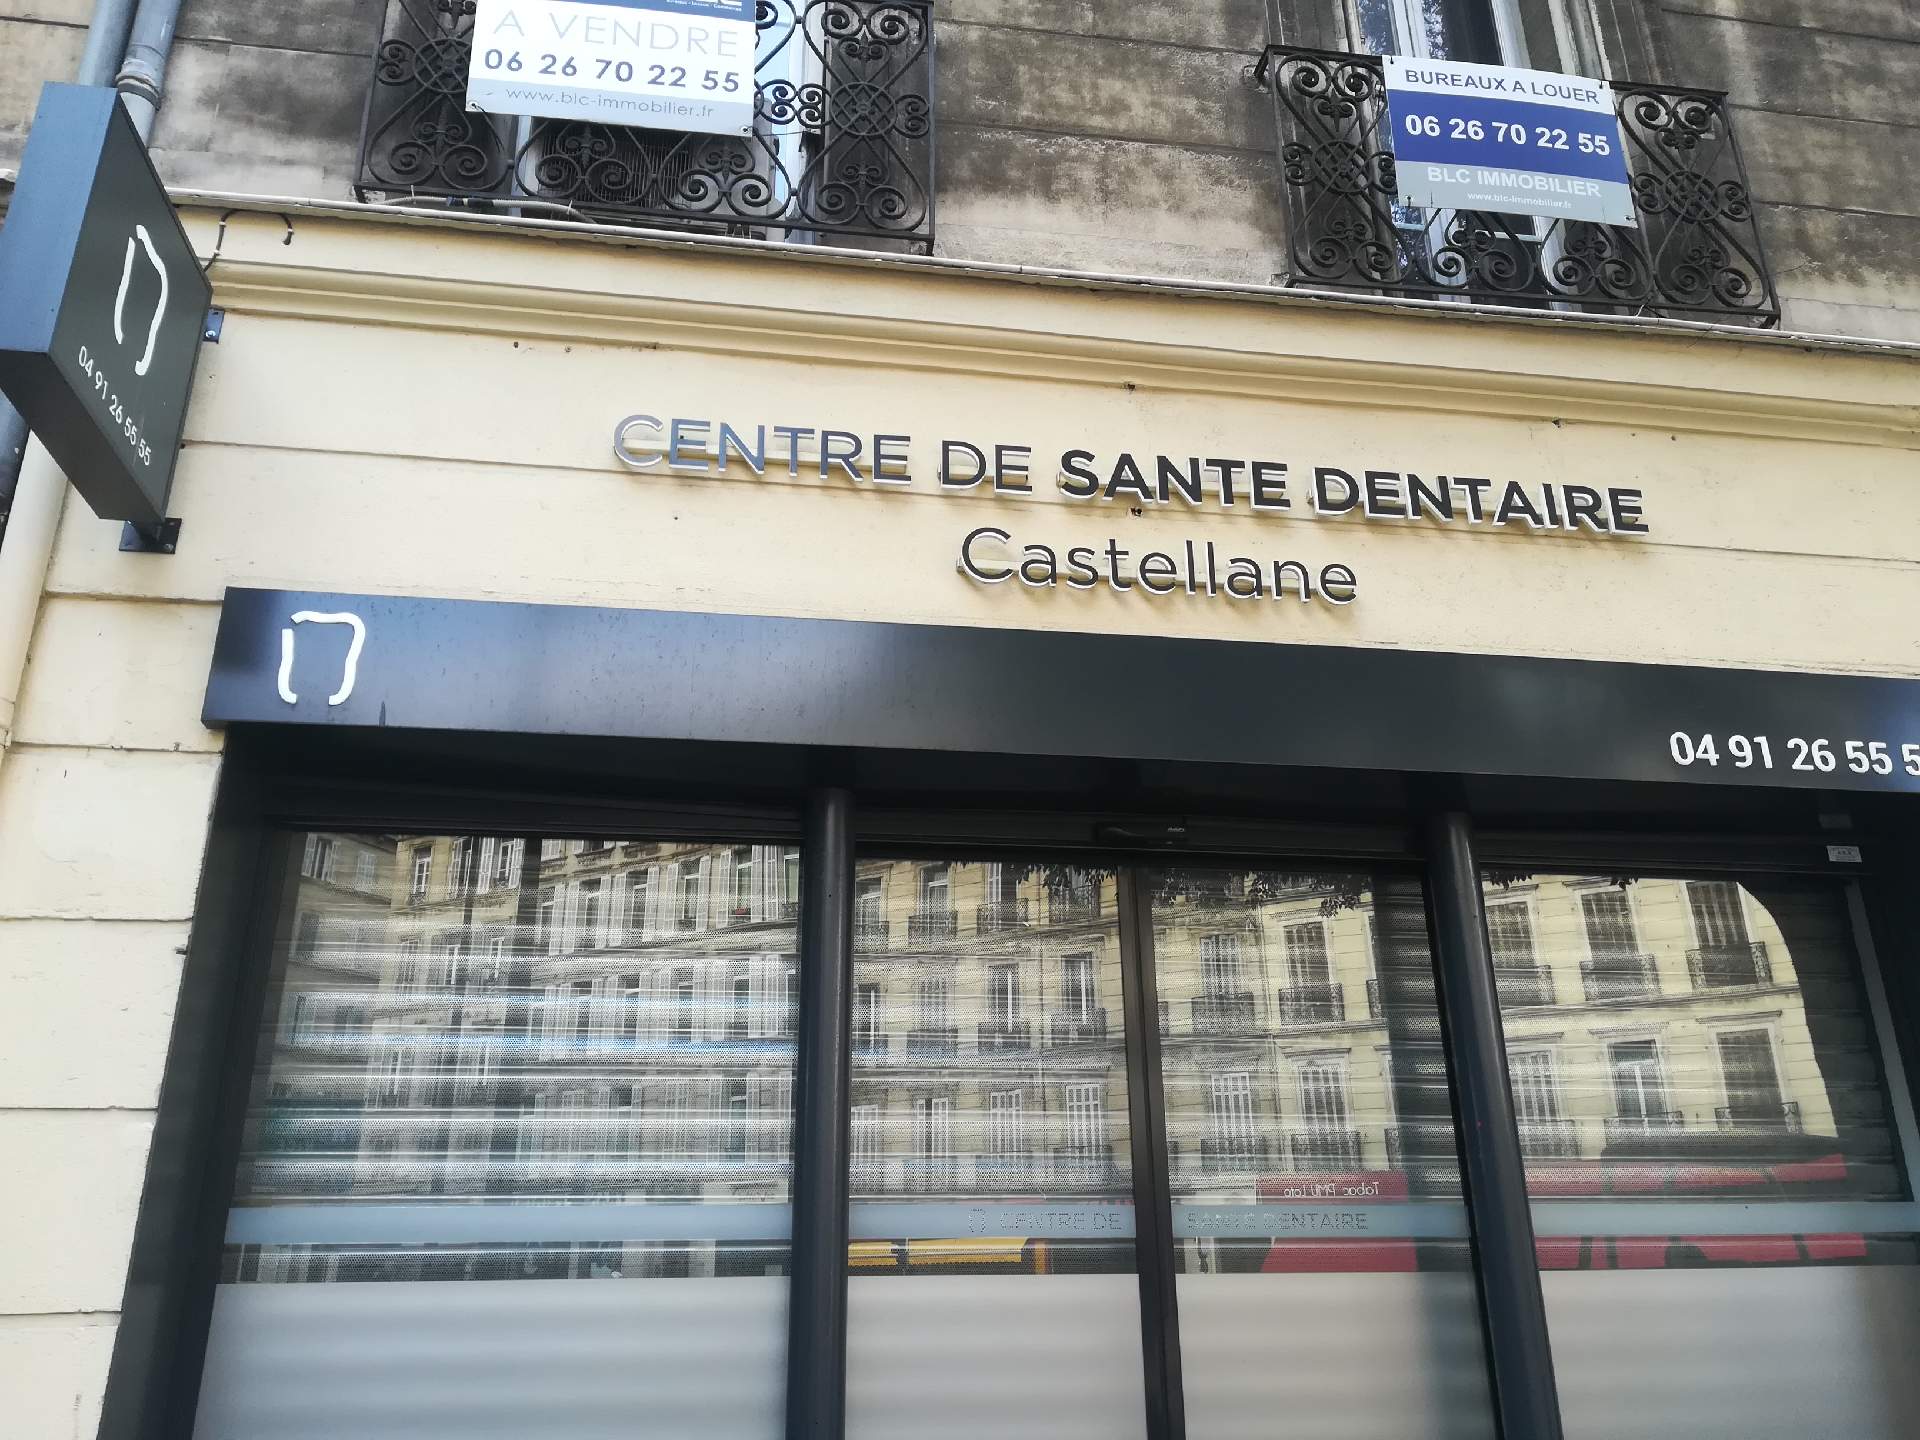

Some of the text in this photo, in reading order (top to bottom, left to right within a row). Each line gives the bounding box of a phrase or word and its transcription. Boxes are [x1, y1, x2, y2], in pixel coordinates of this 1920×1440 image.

[493, 9, 739, 58] A VENDRE
[484, 48, 739, 93] 06 26 70 22 55
[1405, 69, 1600, 105] BUREAUX A LOUER
[505, 87, 715, 118] www.blc-immobilier.fr
[1405, 114, 1610, 156] 06 26 70 22 55
[1427, 166, 1602, 198] BLC IMMOBILIER
[78, 345, 151, 466] 04 91 26 55 55
[614, 413, 1650, 535] CENTRE DE SANTE DENTAIRE
[959, 527, 1358, 605] Castellane
[1670, 731, 1719, 766] 04
[1728, 735, 1773, 768] 91
[1787, 738, 1836, 772] 26
[1845, 741, 1893, 775] 55
[1093, 1213, 1122, 1230] DE
